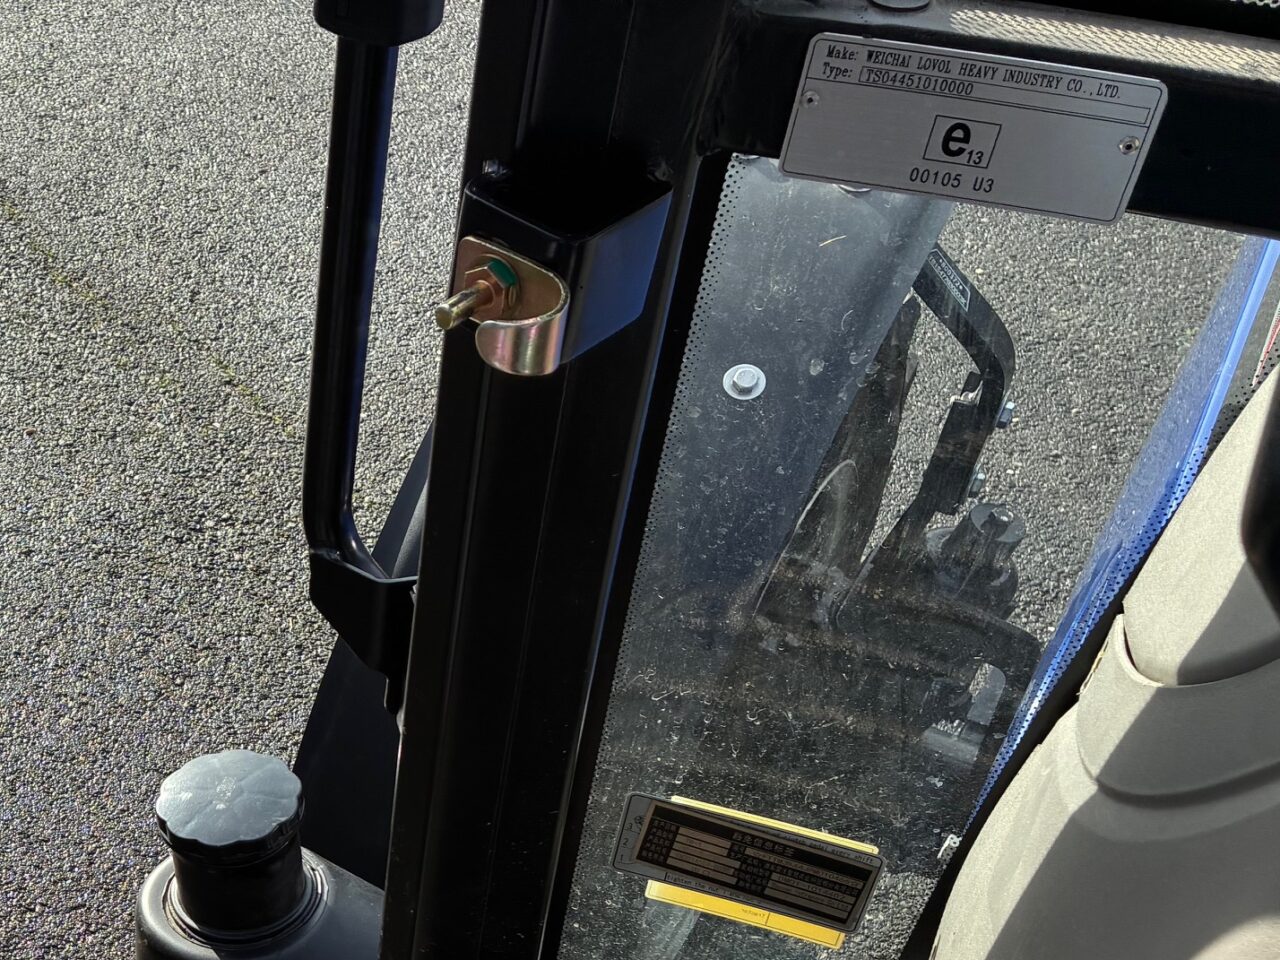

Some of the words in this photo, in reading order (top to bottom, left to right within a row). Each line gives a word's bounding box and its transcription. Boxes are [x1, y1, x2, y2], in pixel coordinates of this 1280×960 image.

[822, 62, 853, 80] Type:
[866, 68, 974, 96] TS04451010000
[826, 44, 859, 61] Make:
[866, 50, 912, 68] WEICHAI
[917, 56, 951, 74] LOVOL
[958, 62, 999, 81] HEAVY
[1003, 69, 1064, 90] INDUSTRY
[909, 167, 962, 188] 00105
[973, 176, 994, 193] U3
